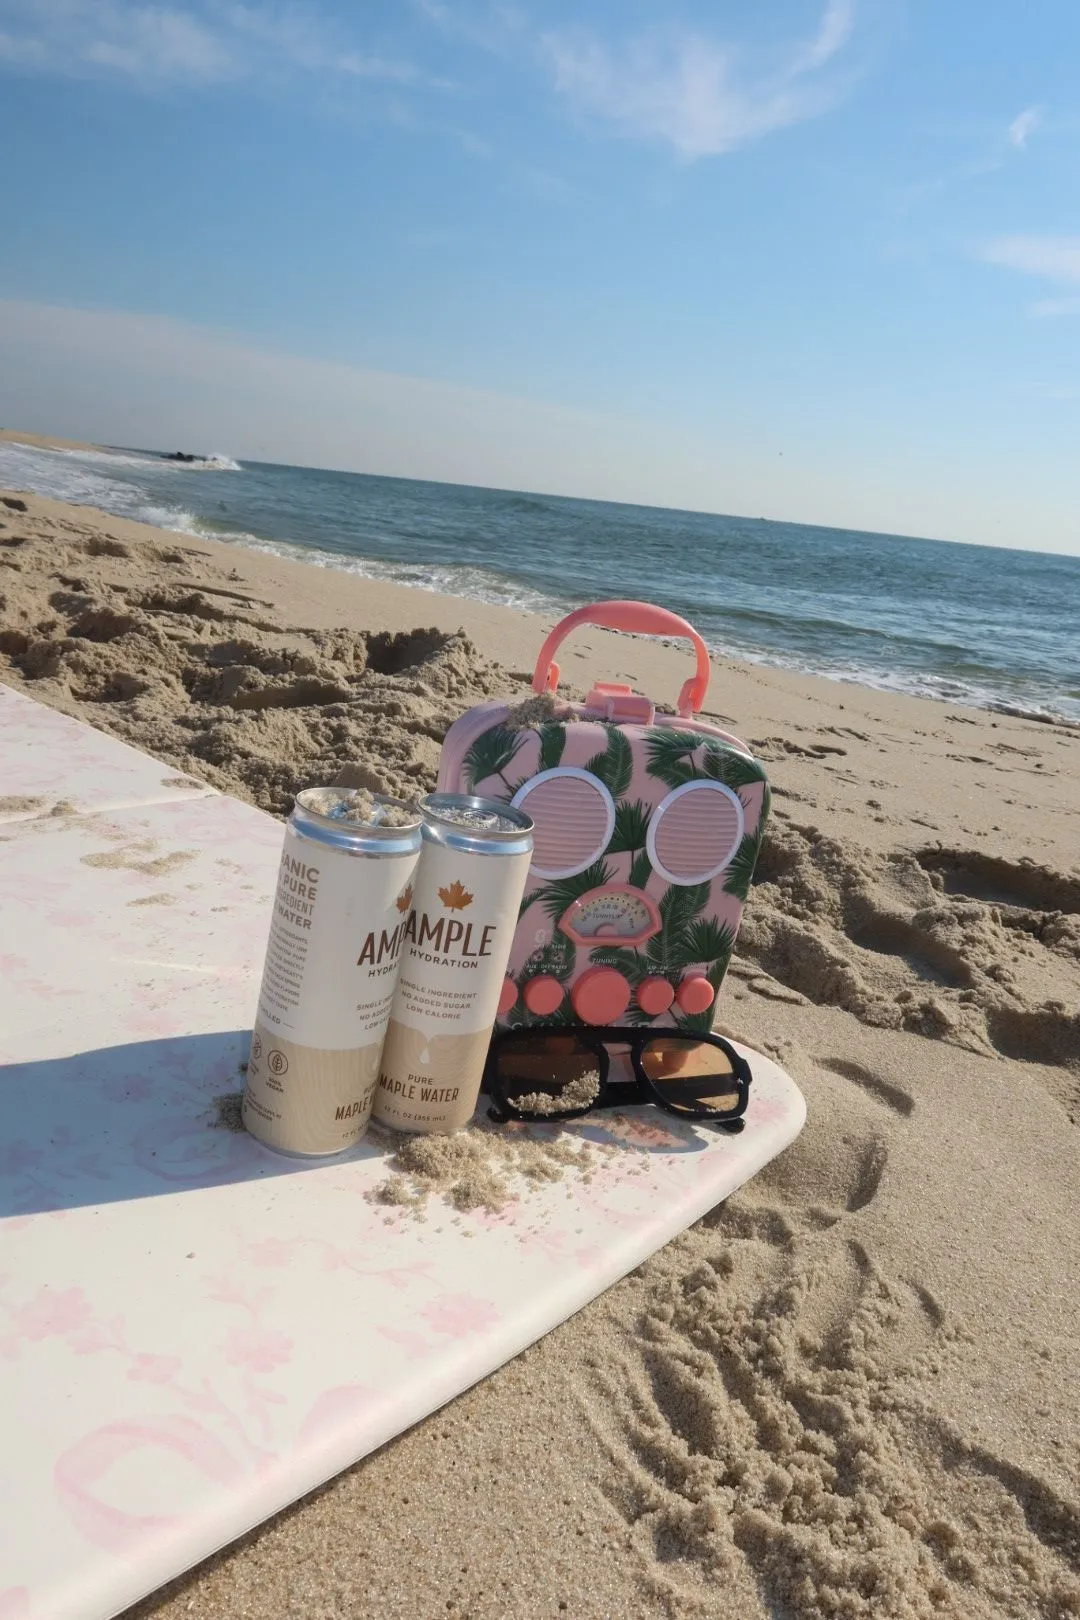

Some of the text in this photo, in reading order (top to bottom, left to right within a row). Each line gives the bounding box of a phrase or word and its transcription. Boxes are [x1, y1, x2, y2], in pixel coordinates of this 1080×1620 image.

[283, 873, 317, 901] PURE
[278, 904, 313, 930] WATER
[357, 920, 407, 966] AMP
[404, 909, 497, 957] AMPLE
[410, 947, 478, 969] HYDRATION
[400, 977, 478, 999] SINGLE INGREDIENT
[401, 990, 412, 999] NO
[413, 995, 441, 1007] ADDED
[443, 1000, 471, 1010] SUGAR
[406, 1003, 462, 1020] LOW CALORIE
[380, 1073, 416, 1100] MAPLE
[421, 1087, 460, 1102] WATER
[407, 1073, 434, 1086] PURE
[335, 1096, 369, 1120] MAPLE
